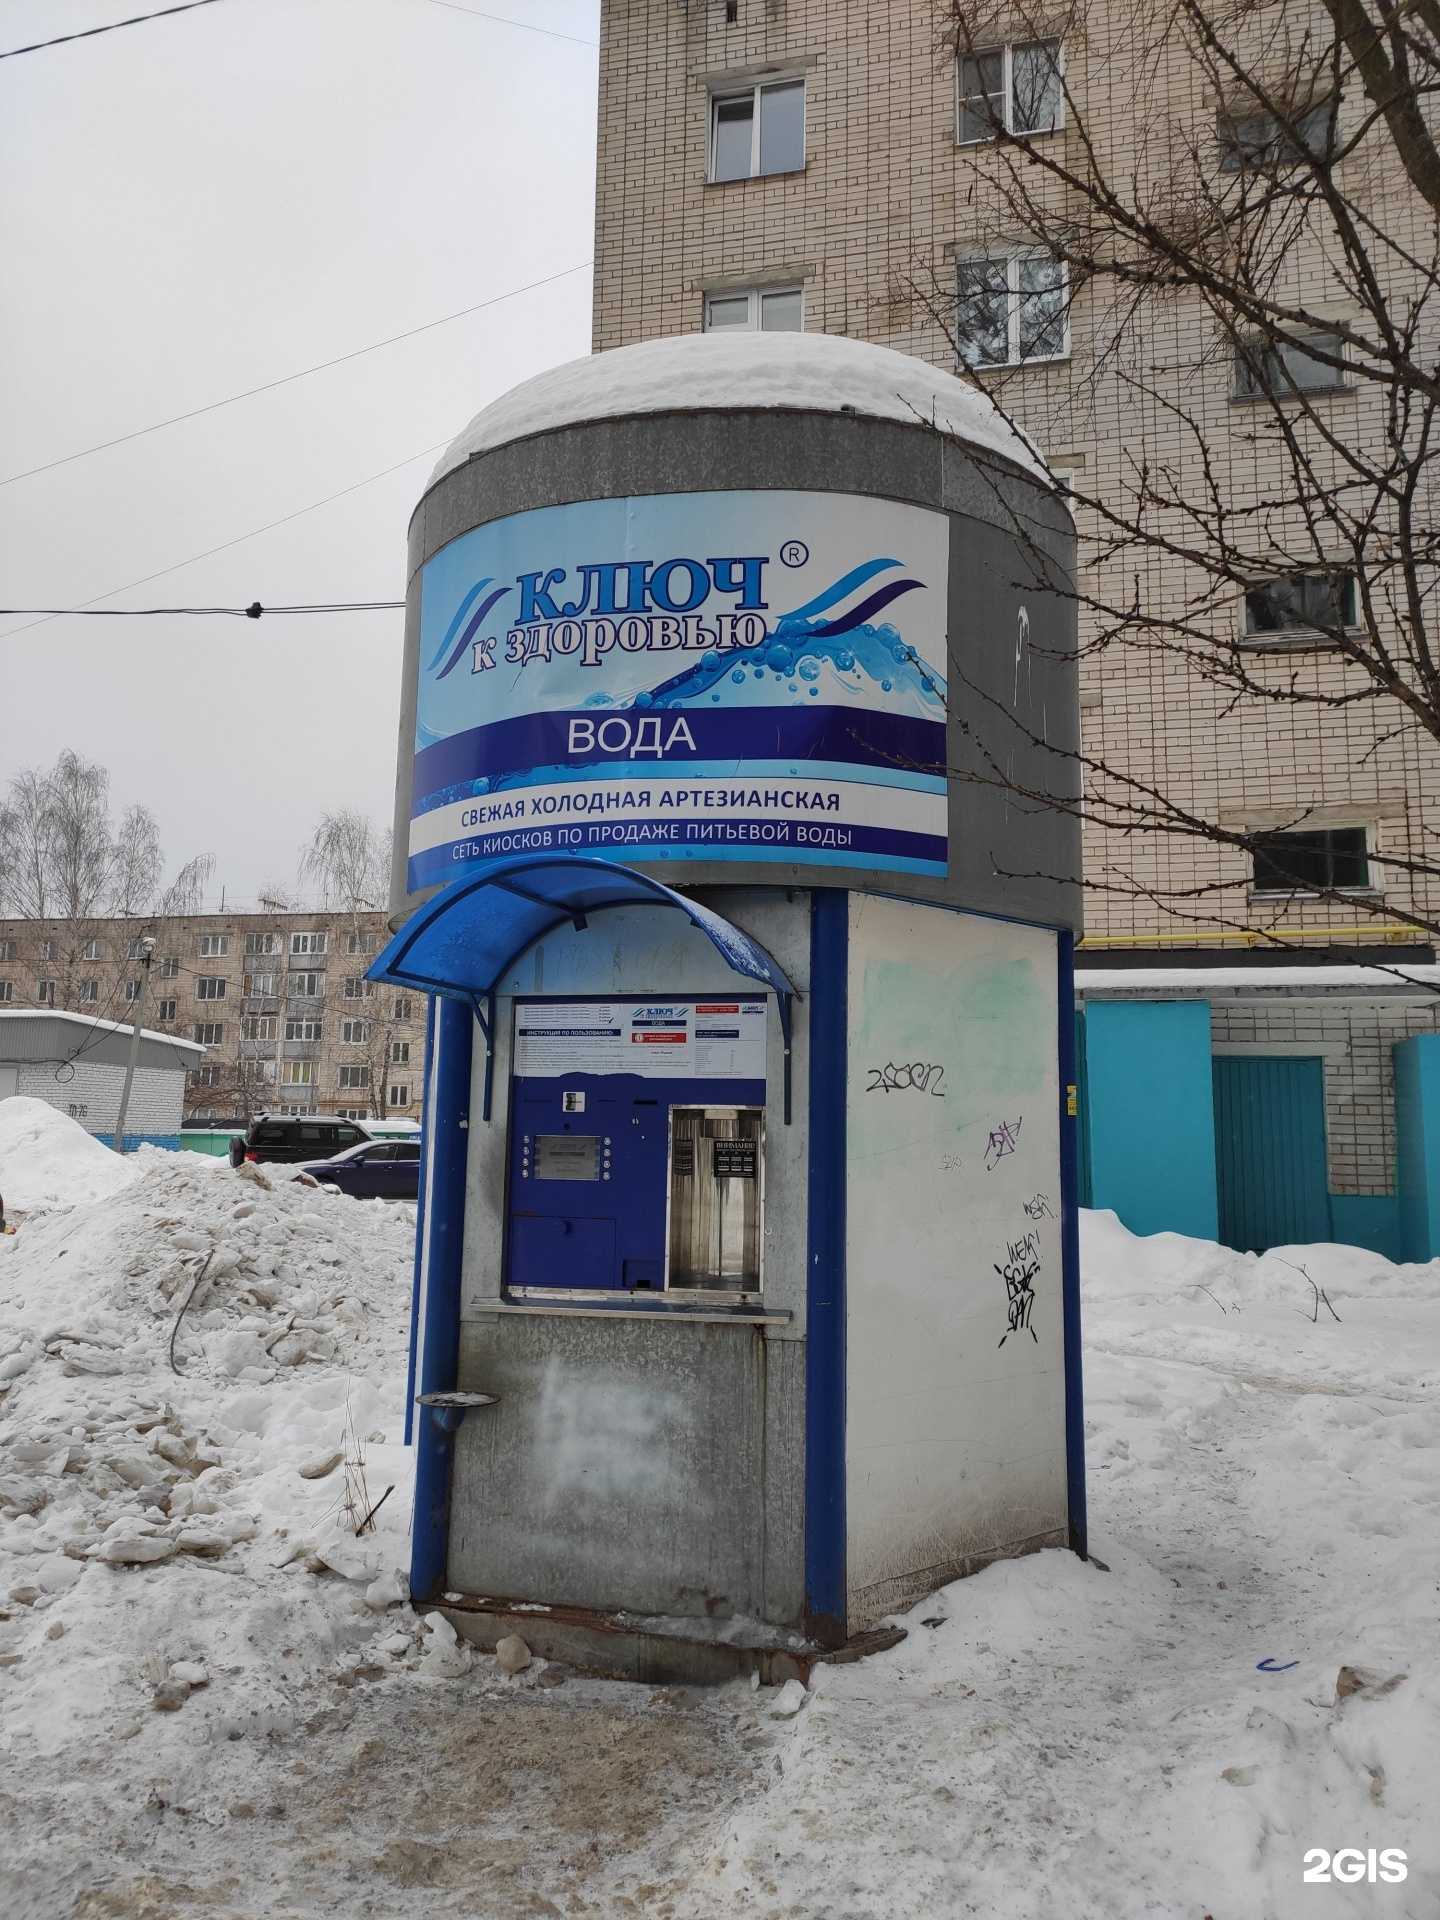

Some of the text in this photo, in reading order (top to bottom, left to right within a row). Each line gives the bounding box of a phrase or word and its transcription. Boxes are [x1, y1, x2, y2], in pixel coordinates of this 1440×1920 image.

[566, 716, 697, 759] ВОДА
[460, 789, 841, 828] СВЕЖАЯ ХОЛОДНАЯ АРТЕЗИАНСКАЯ
[452, 821, 852, 861] СЕТЬ КИОСКОВ ПО ПРОДАЖЕ ПИТЬЕВОЙ ВОДЫ
